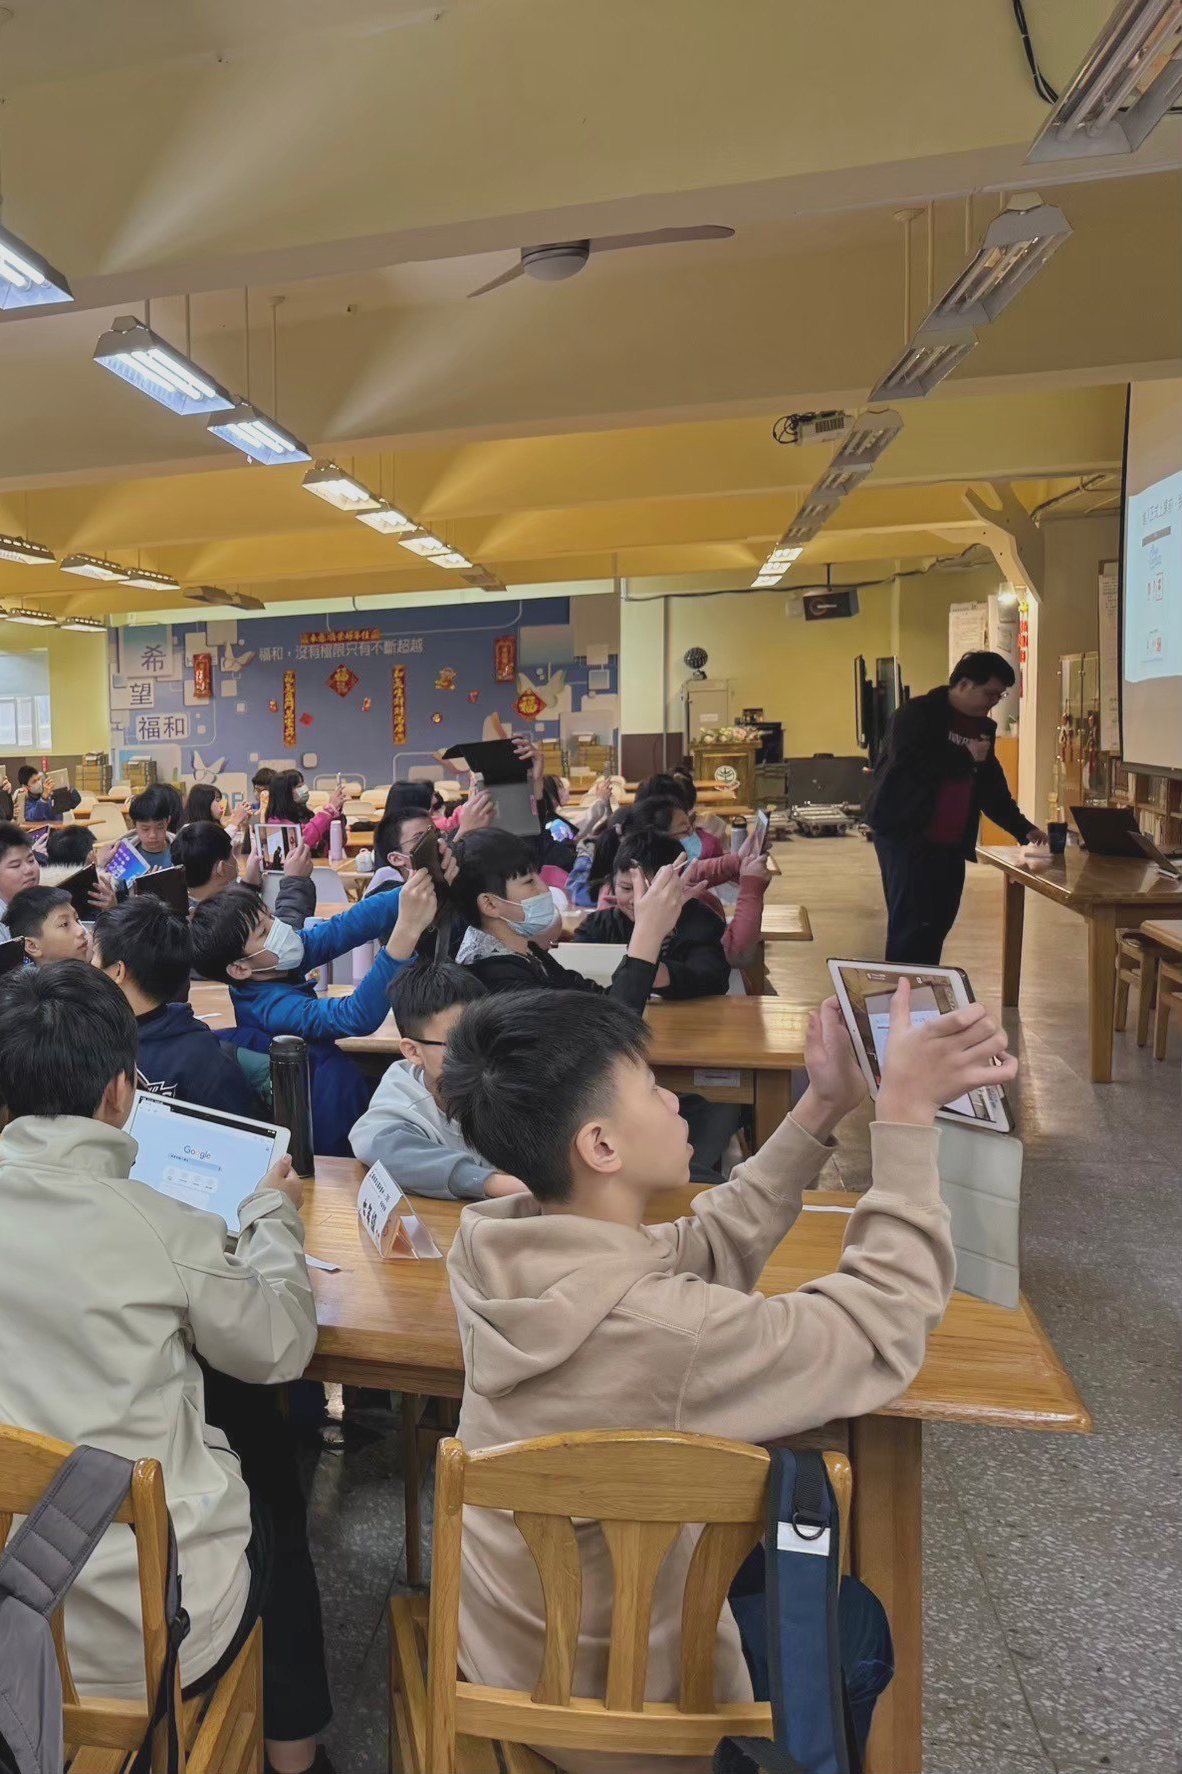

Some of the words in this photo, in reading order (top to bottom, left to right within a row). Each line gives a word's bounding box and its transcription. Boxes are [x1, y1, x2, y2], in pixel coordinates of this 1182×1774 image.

[141, 644, 166, 672] 希
[130, 683, 153, 706] 望
[518, 696, 539, 714] 福
[138, 715, 185, 740] 福和
[183, 1145, 211, 1160] Google
